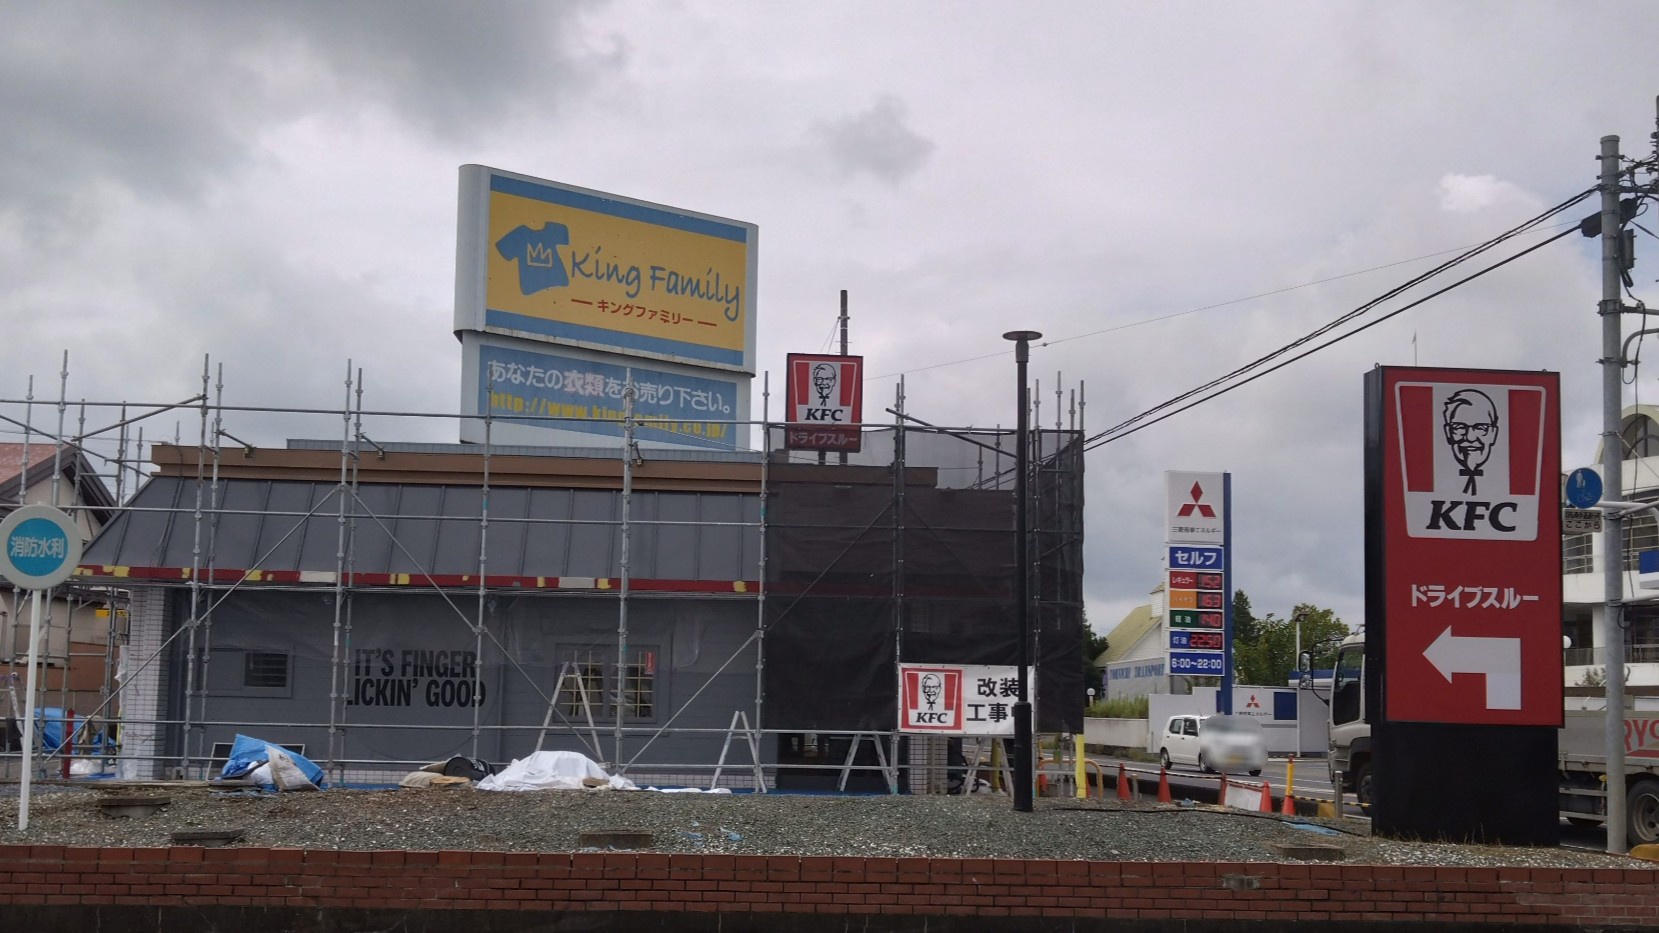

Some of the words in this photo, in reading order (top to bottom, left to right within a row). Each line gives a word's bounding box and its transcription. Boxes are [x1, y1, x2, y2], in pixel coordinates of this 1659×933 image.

[571, 246, 641, 298] King
[650, 265, 740, 321] Family
[597, 300, 693, 325] キングファミリー
[490, 391, 729, 438] http://www.kingamily.co.jp/
[804, 408, 844, 421] KFC
[1426, 500, 1518, 532] KFC
[10, 536, 65, 558] 消防水利
[1174, 550, 1217, 565] セルフ
[1411, 584, 1539, 609] ドライブスルー
[354, 648, 395, 677] IT'S
[401, 650, 479, 678] FINGER
[346, 678, 419, 706] ICKIN'
[425, 680, 486, 707] GOOD
[977, 678, 1019, 698] 改装
[915, 712, 948, 723] KFC
[966, 703, 1015, 722] 工事
